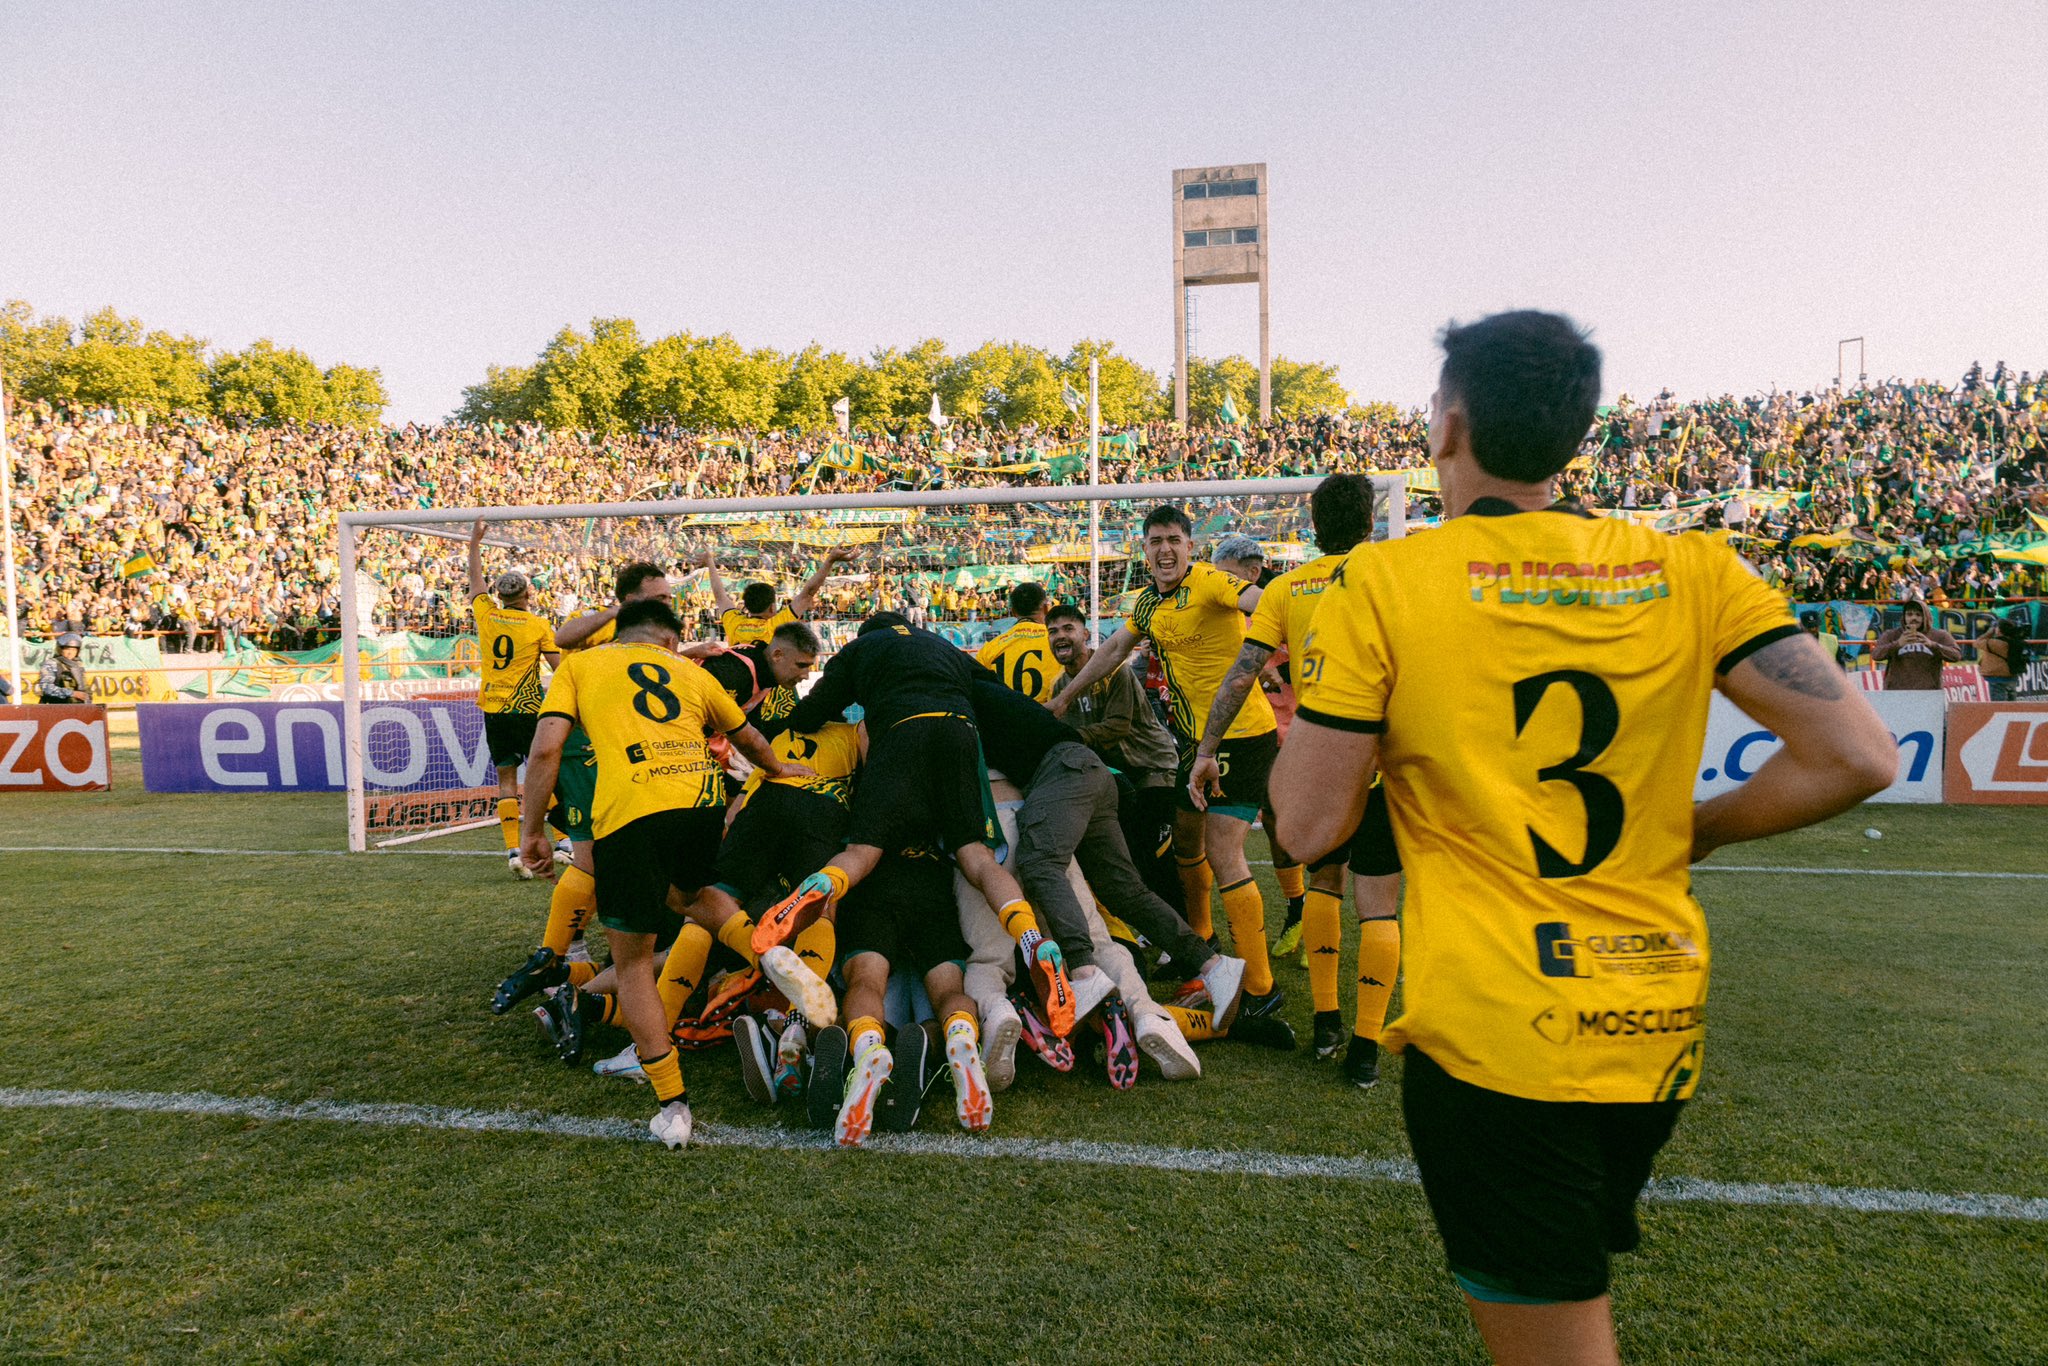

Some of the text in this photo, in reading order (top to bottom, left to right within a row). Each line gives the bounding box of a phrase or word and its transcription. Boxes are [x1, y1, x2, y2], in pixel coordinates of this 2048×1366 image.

[1467, 560, 1669, 605] PLUSMAR
[493, 634, 514, 671] 9
[992, 650, 1042, 700] 16
[627, 662, 681, 724] 8
[1077, 696, 1091, 712] 12
[1513, 669, 1626, 878] 3
